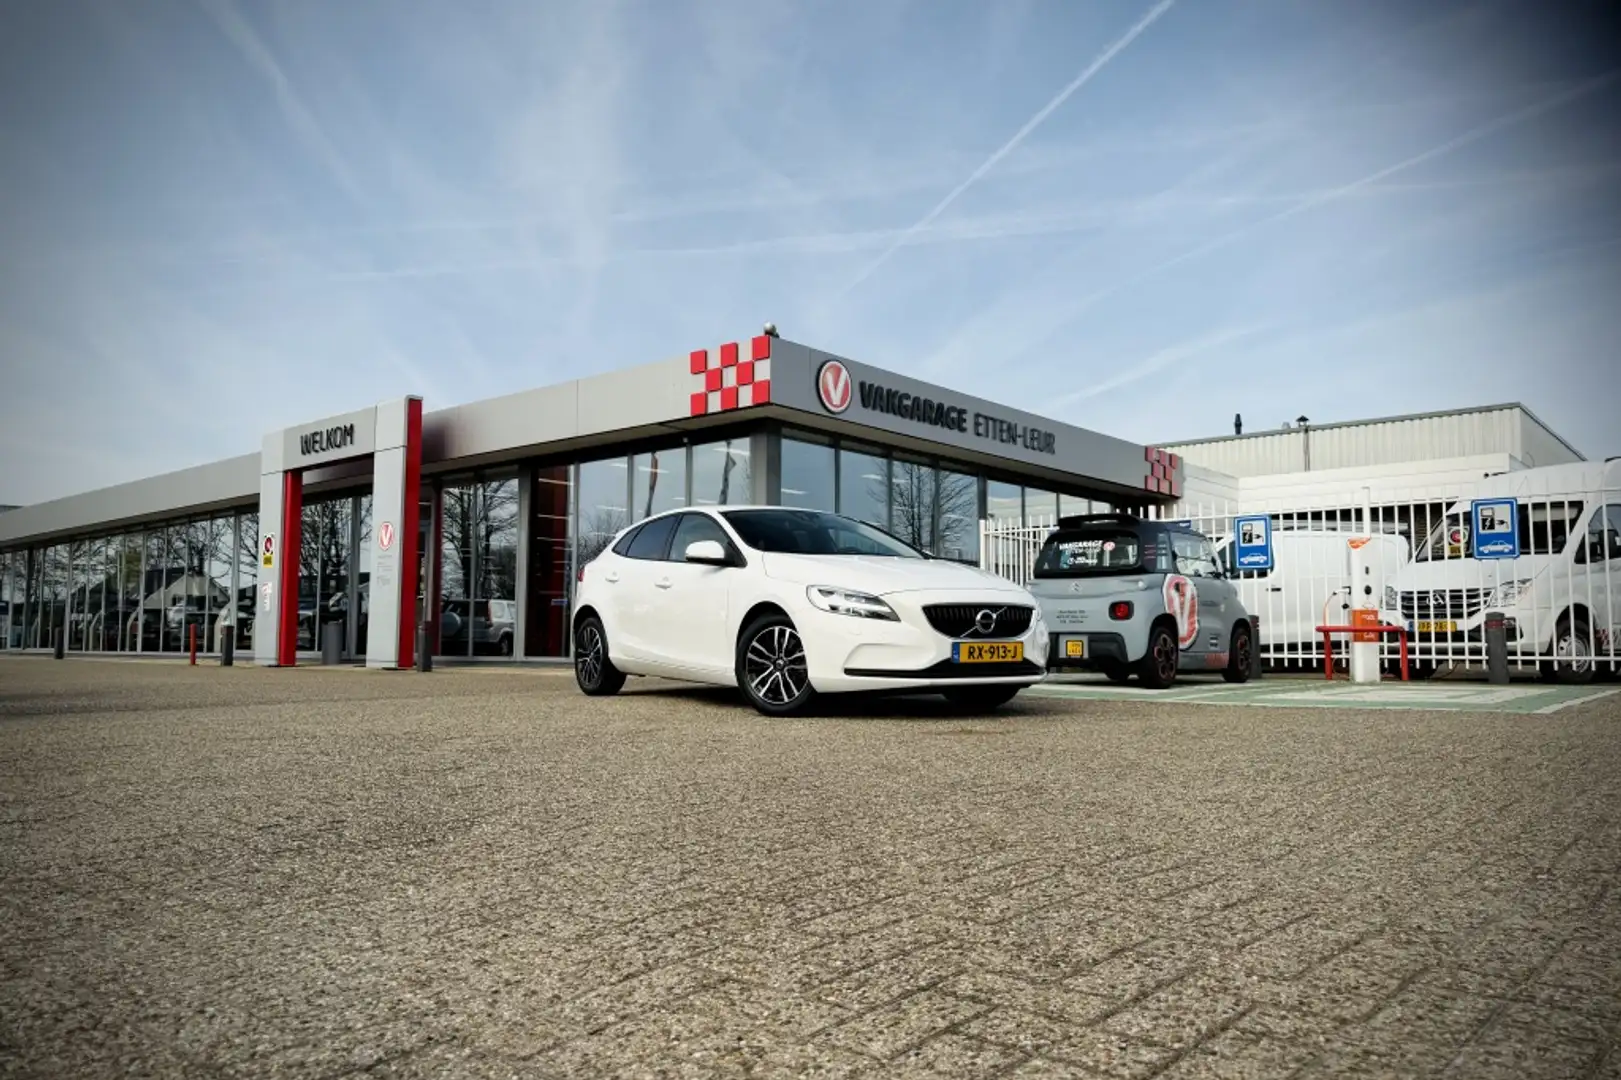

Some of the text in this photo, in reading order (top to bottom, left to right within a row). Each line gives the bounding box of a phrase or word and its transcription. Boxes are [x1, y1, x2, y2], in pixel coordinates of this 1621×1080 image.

[859, 381, 1056, 455] VAKGARAGE ETTEN-LEUR
[300, 423, 354, 456] WELKOM
[968, 645, 1017, 660] RX-913-J
